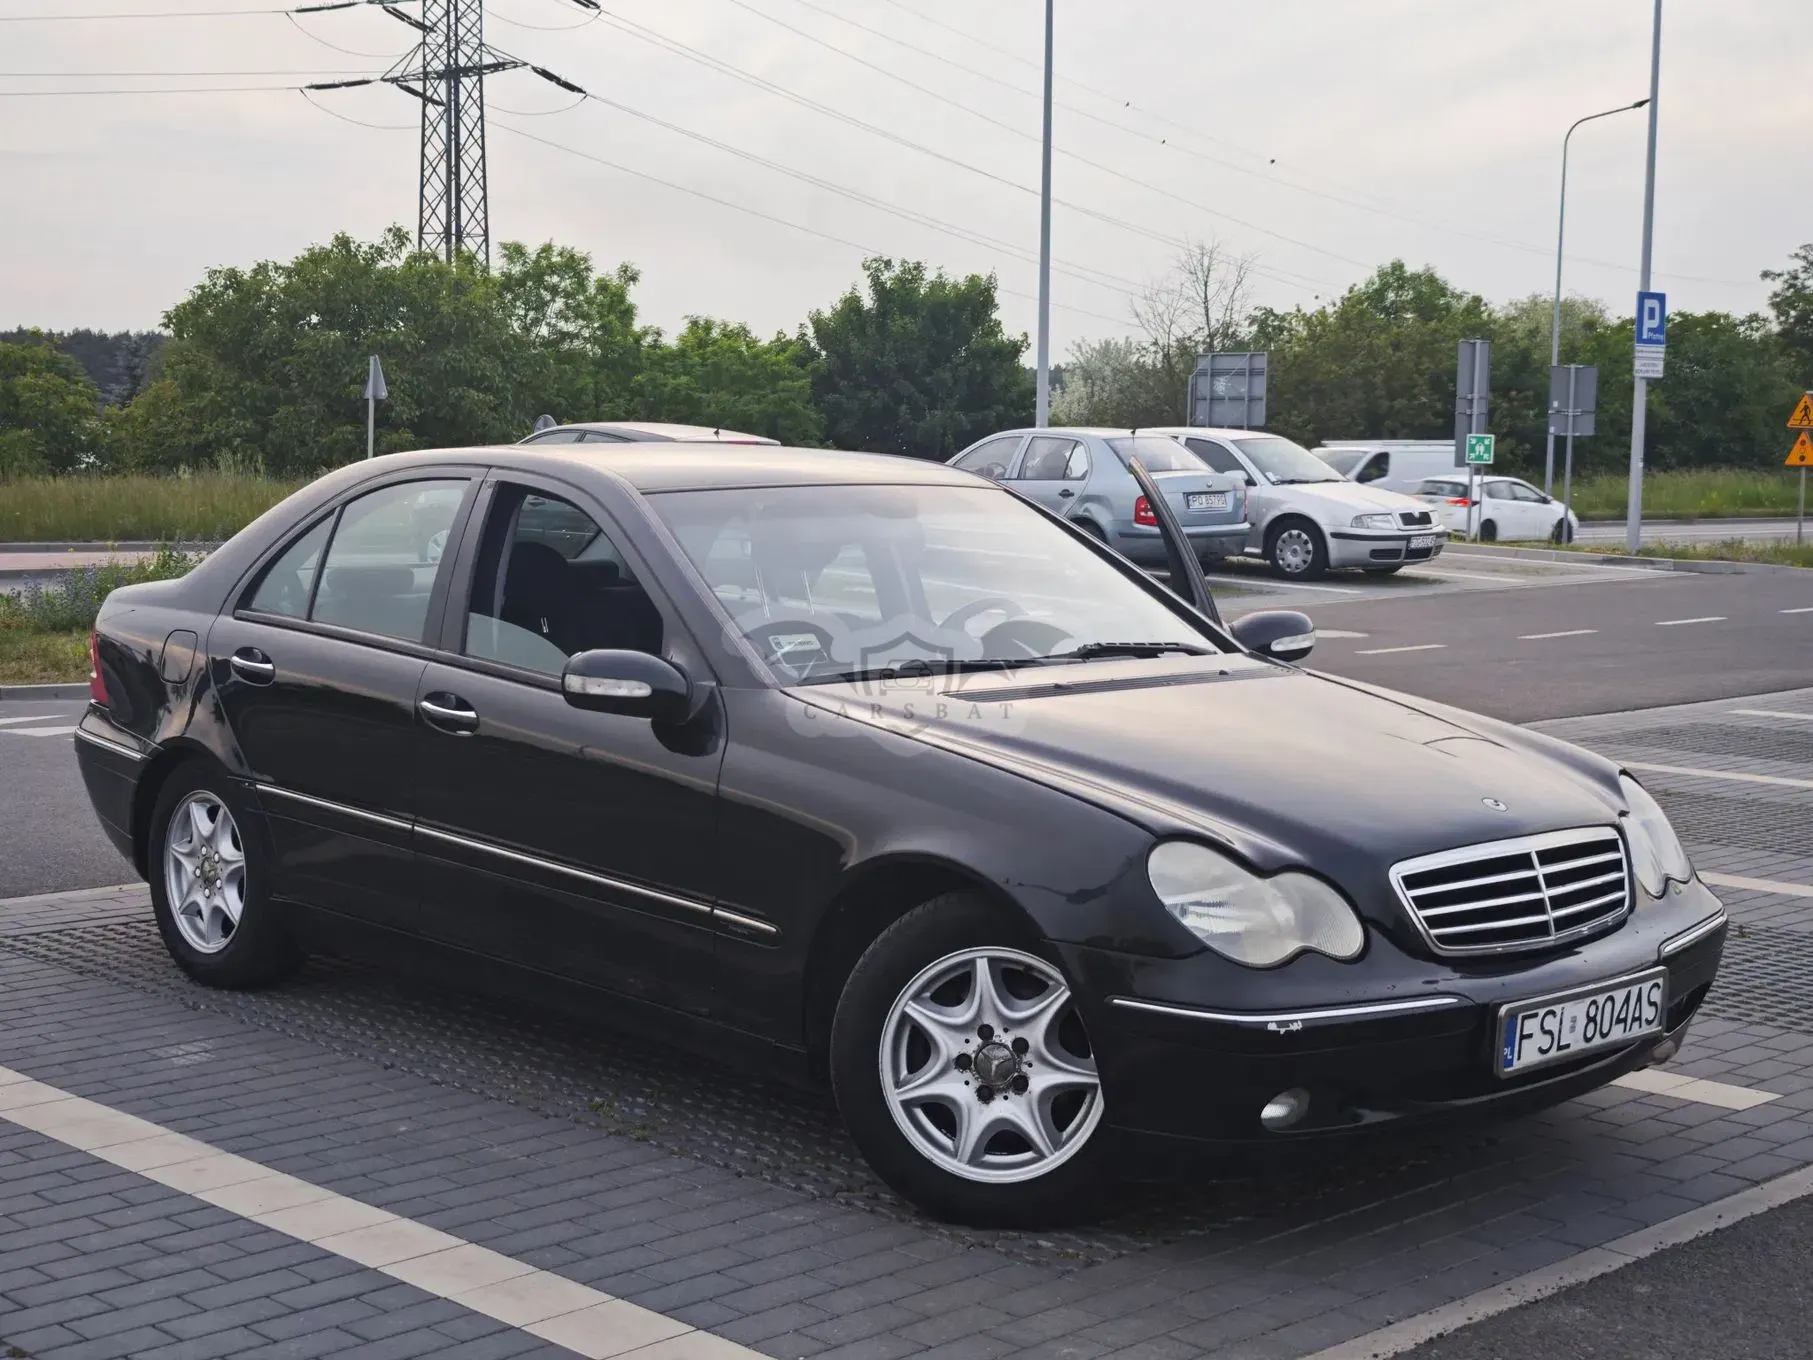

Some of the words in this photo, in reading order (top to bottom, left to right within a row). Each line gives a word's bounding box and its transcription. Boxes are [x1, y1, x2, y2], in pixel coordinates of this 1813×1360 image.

[1642, 299, 1660, 339] P
[1517, 1007, 1571, 1061] FSL
[1583, 982, 1661, 1044] 804AS
[1503, 1047, 1513, 1059] PL
